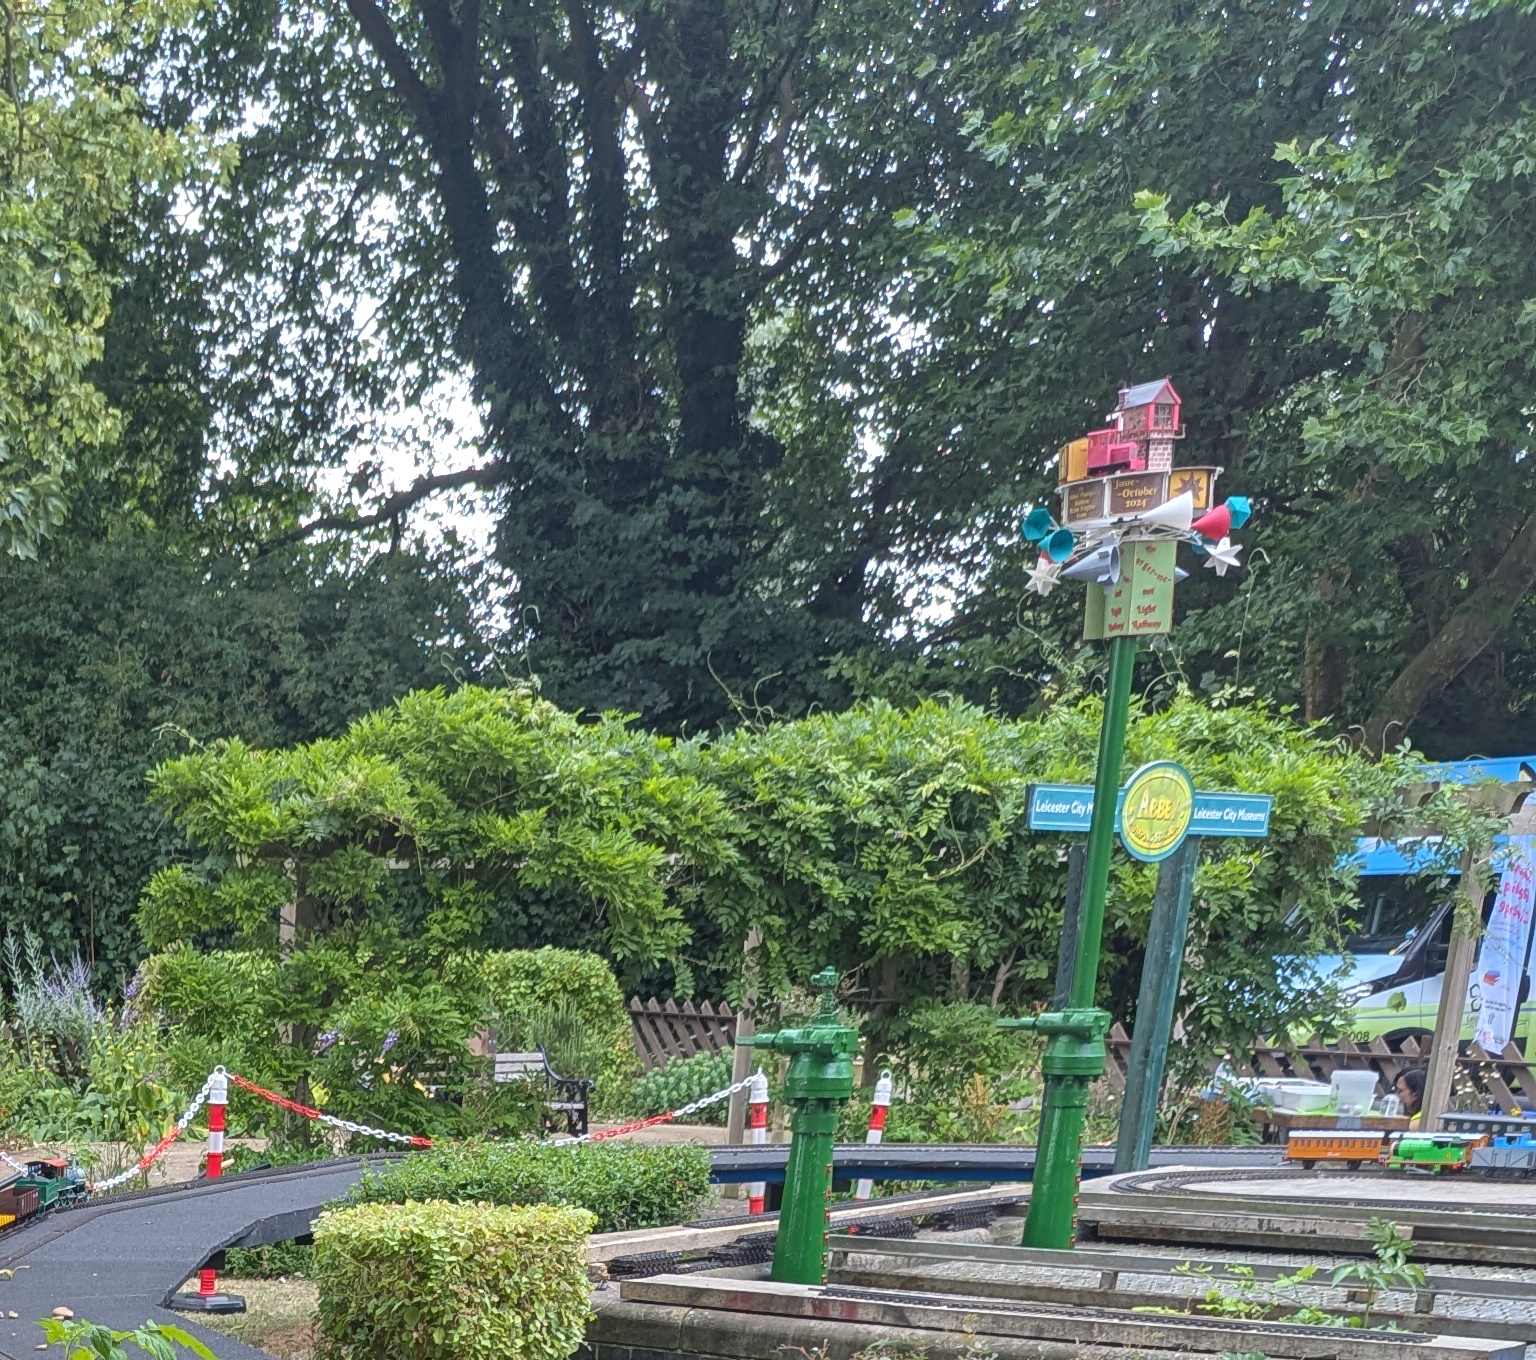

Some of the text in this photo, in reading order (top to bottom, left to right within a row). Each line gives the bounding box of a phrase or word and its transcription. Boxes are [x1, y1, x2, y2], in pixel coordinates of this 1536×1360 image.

[1125, 498, 1147, 508] 2024
[1035, 800, 1070, 814] Leicester
[1071, 801, 1086, 817] City
[1193, 807, 1266, 823] Leicester City Museums
